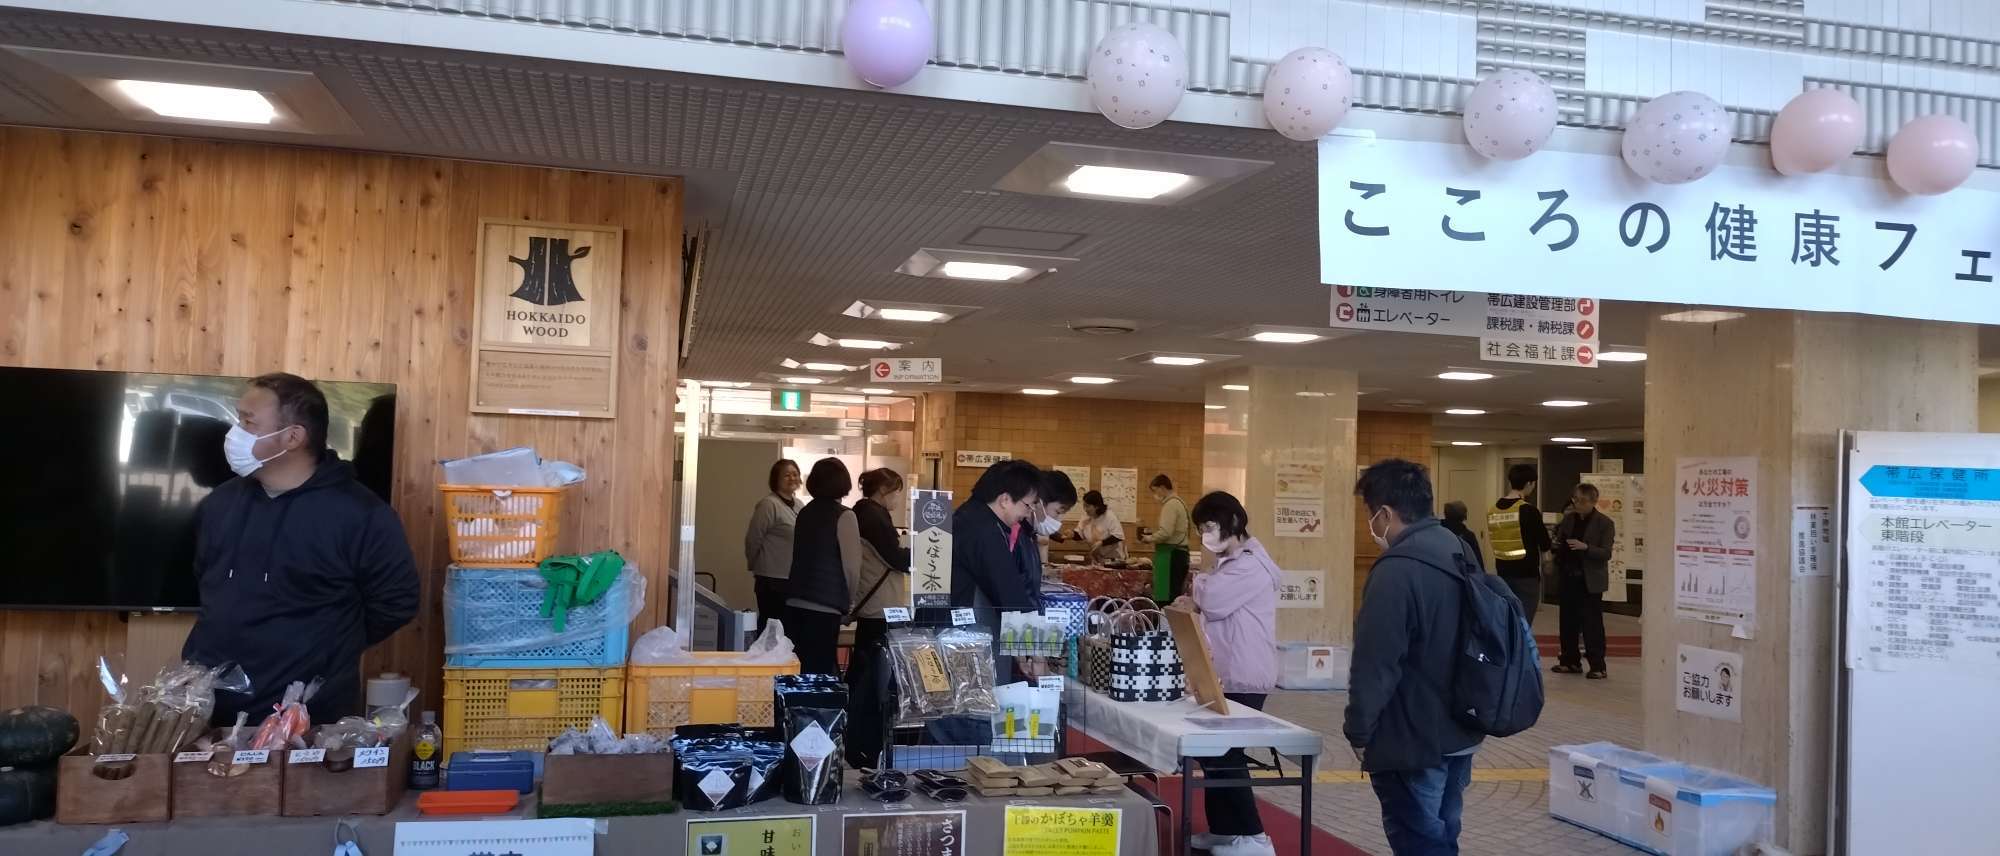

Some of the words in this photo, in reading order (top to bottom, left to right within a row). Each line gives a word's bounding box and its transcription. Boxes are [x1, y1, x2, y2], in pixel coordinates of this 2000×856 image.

[1344, 180, 1993, 284] こころの健康フェ
[1487, 292, 1576, 312] 帯広建設管理部
[506, 310, 586, 325] HOKKAIDO
[1373, 309, 1451, 325] エレベーター
[522, 325, 569, 338] WOOD
[1486, 316, 1575, 336] 課税課・納税課
[1487, 341, 1575, 361] 社会福祉課
[898, 360, 935, 372] 案内
[1886, 465, 1989, 481] 帯広保健所
[1693, 478, 1749, 497] 火災対策
[1881, 515, 1993, 532] 本館エレベーター
[1881, 530, 1926, 544] 東階段
[922, 530, 943, 592] ごぼう茶
[1280, 584, 1301, 593] ご協力
[1280, 592, 1318, 601] お願いします
[1683, 671, 1710, 689] ご協力
[1683, 686, 1733, 707] お願いします
[412, 760, 435, 770] BLACK
